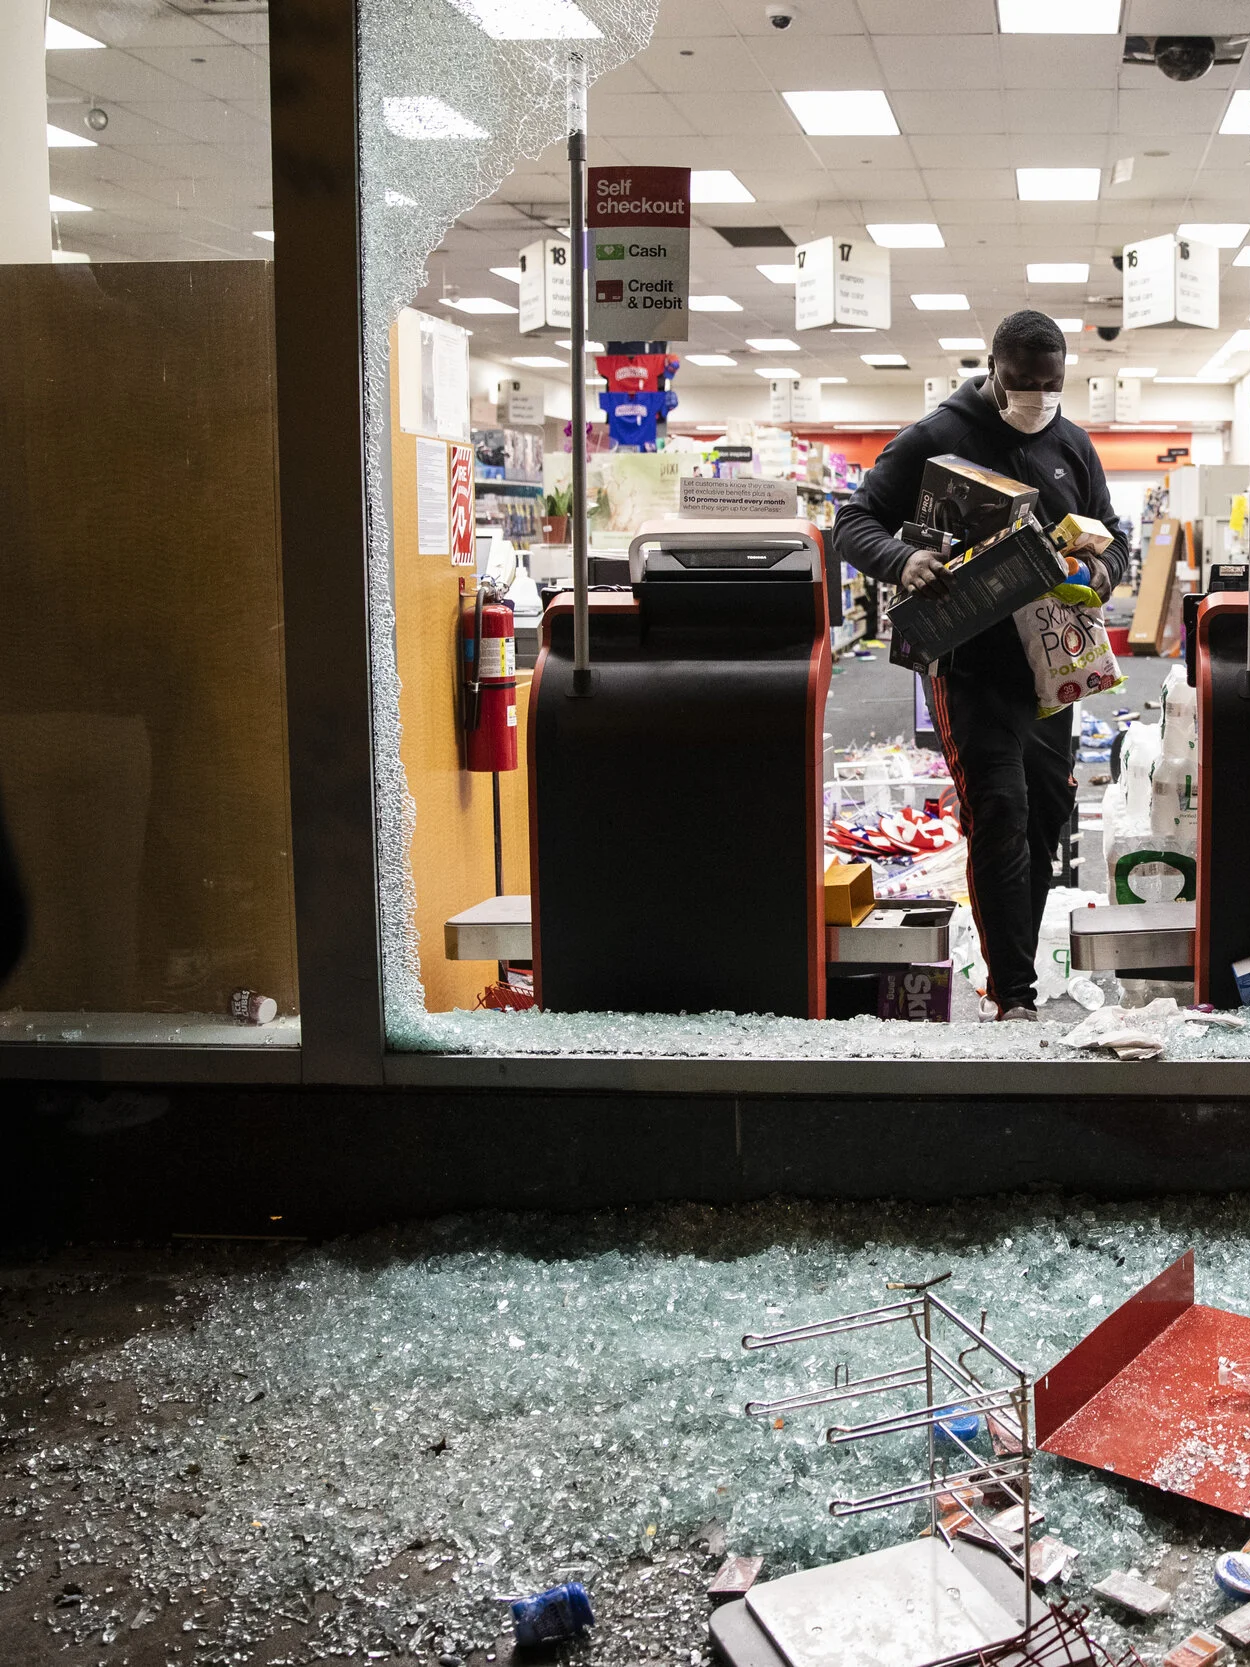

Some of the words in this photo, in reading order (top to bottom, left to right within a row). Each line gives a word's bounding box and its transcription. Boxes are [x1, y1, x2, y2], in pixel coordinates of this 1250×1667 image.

[596, 179, 633, 197] Self
[596, 197, 685, 215] checkout
[550, 246, 566, 266] 18
[628, 244, 667, 258] Cash
[797, 250, 806, 268] 17
[839, 243, 852, 262] 17
[1127, 250, 1138, 268] 16
[628, 279, 674, 293] Credit
[628, 296, 639, 310] &
[643, 296, 683, 310] Debit
[695, 488, 725, 496] exclusive
[752, 490, 767, 498] plus
[748, 482, 761, 490] they
[696, 497, 719, 505] promo
[719, 497, 744, 505] reward
[744, 498, 763, 506] every
[763, 498, 786, 506] month
[701, 504, 715, 512] they
[716, 505, 729, 513] sign
[1041, 612, 1097, 667] POP
[1049, 643, 1109, 679] POPCORN
[241, 990, 250, 1017] CUBES
